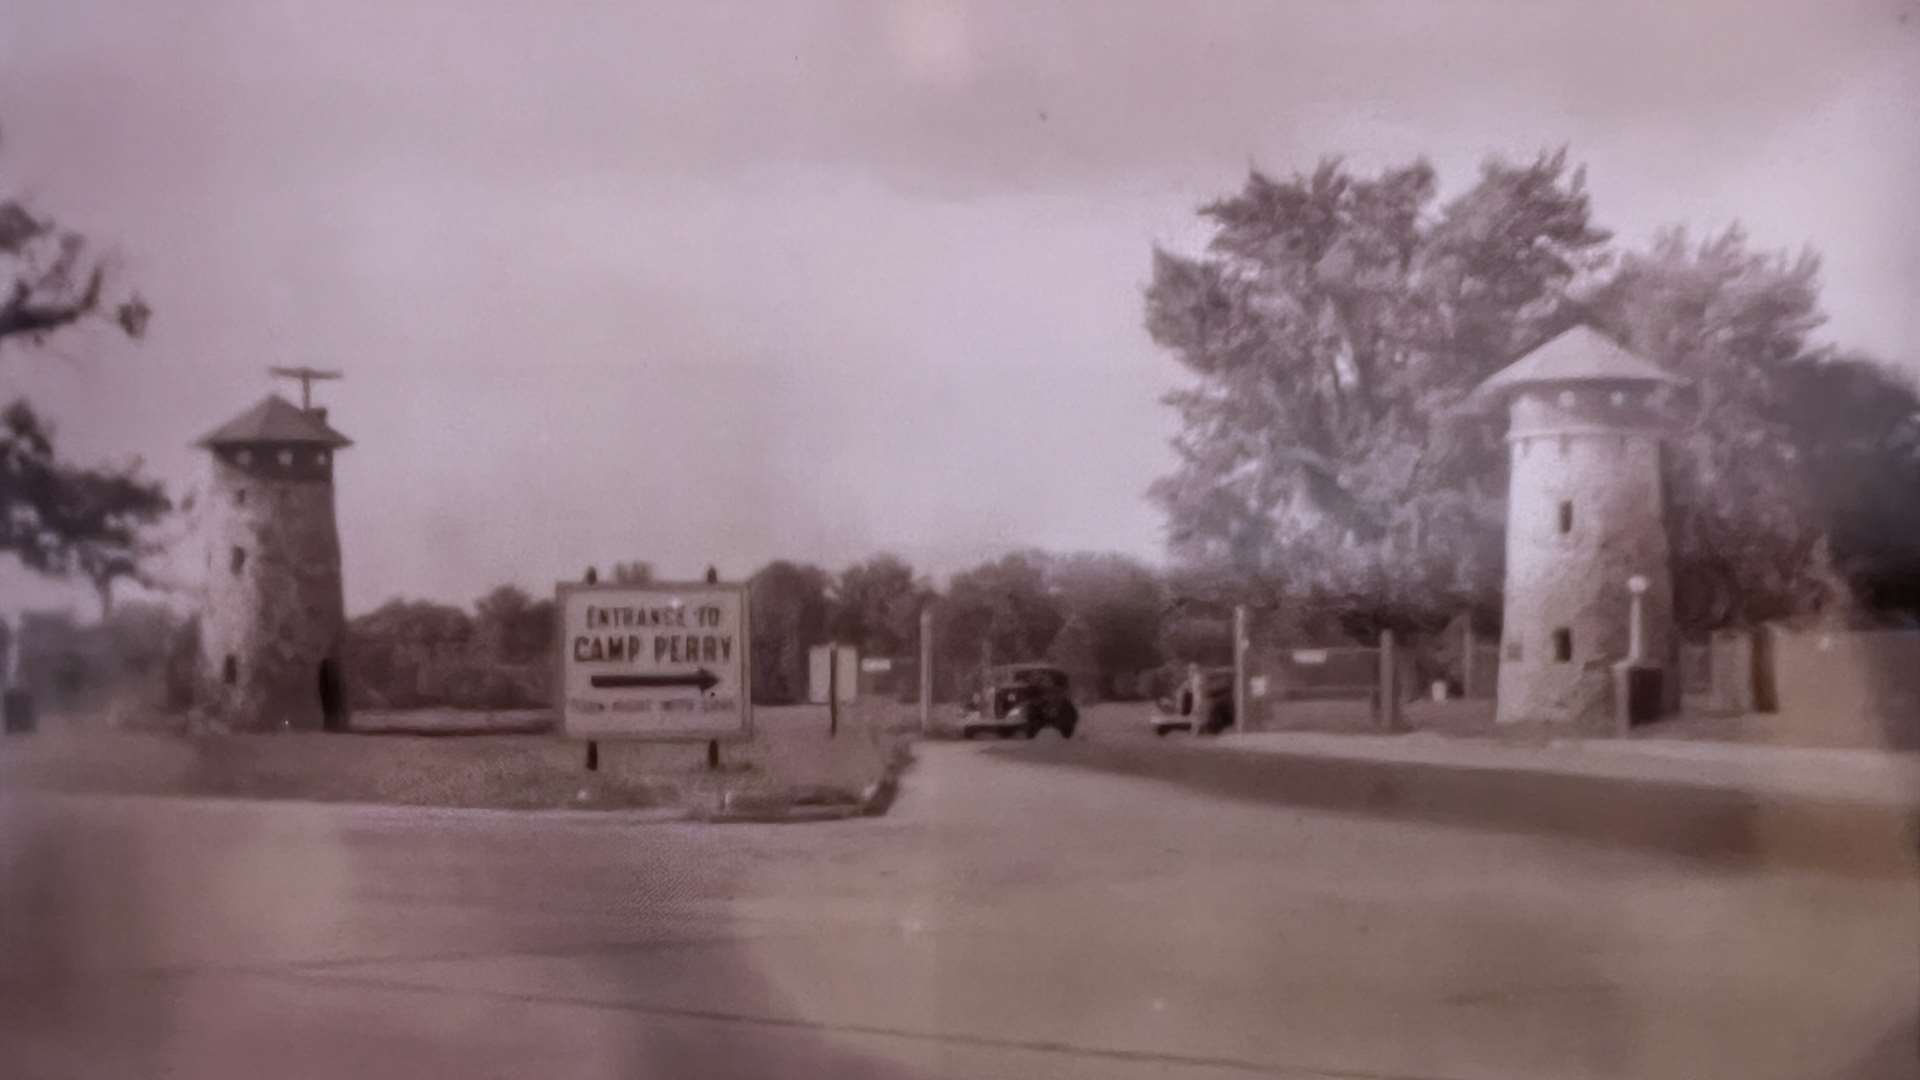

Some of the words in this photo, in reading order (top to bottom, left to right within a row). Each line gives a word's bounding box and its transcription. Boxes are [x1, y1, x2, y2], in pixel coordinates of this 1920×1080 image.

[586, 605, 686, 629] ENTRANCE
[696, 606, 721, 628] TO
[573, 635, 641, 663] CAMP
[653, 635, 732, 663] PERRY
